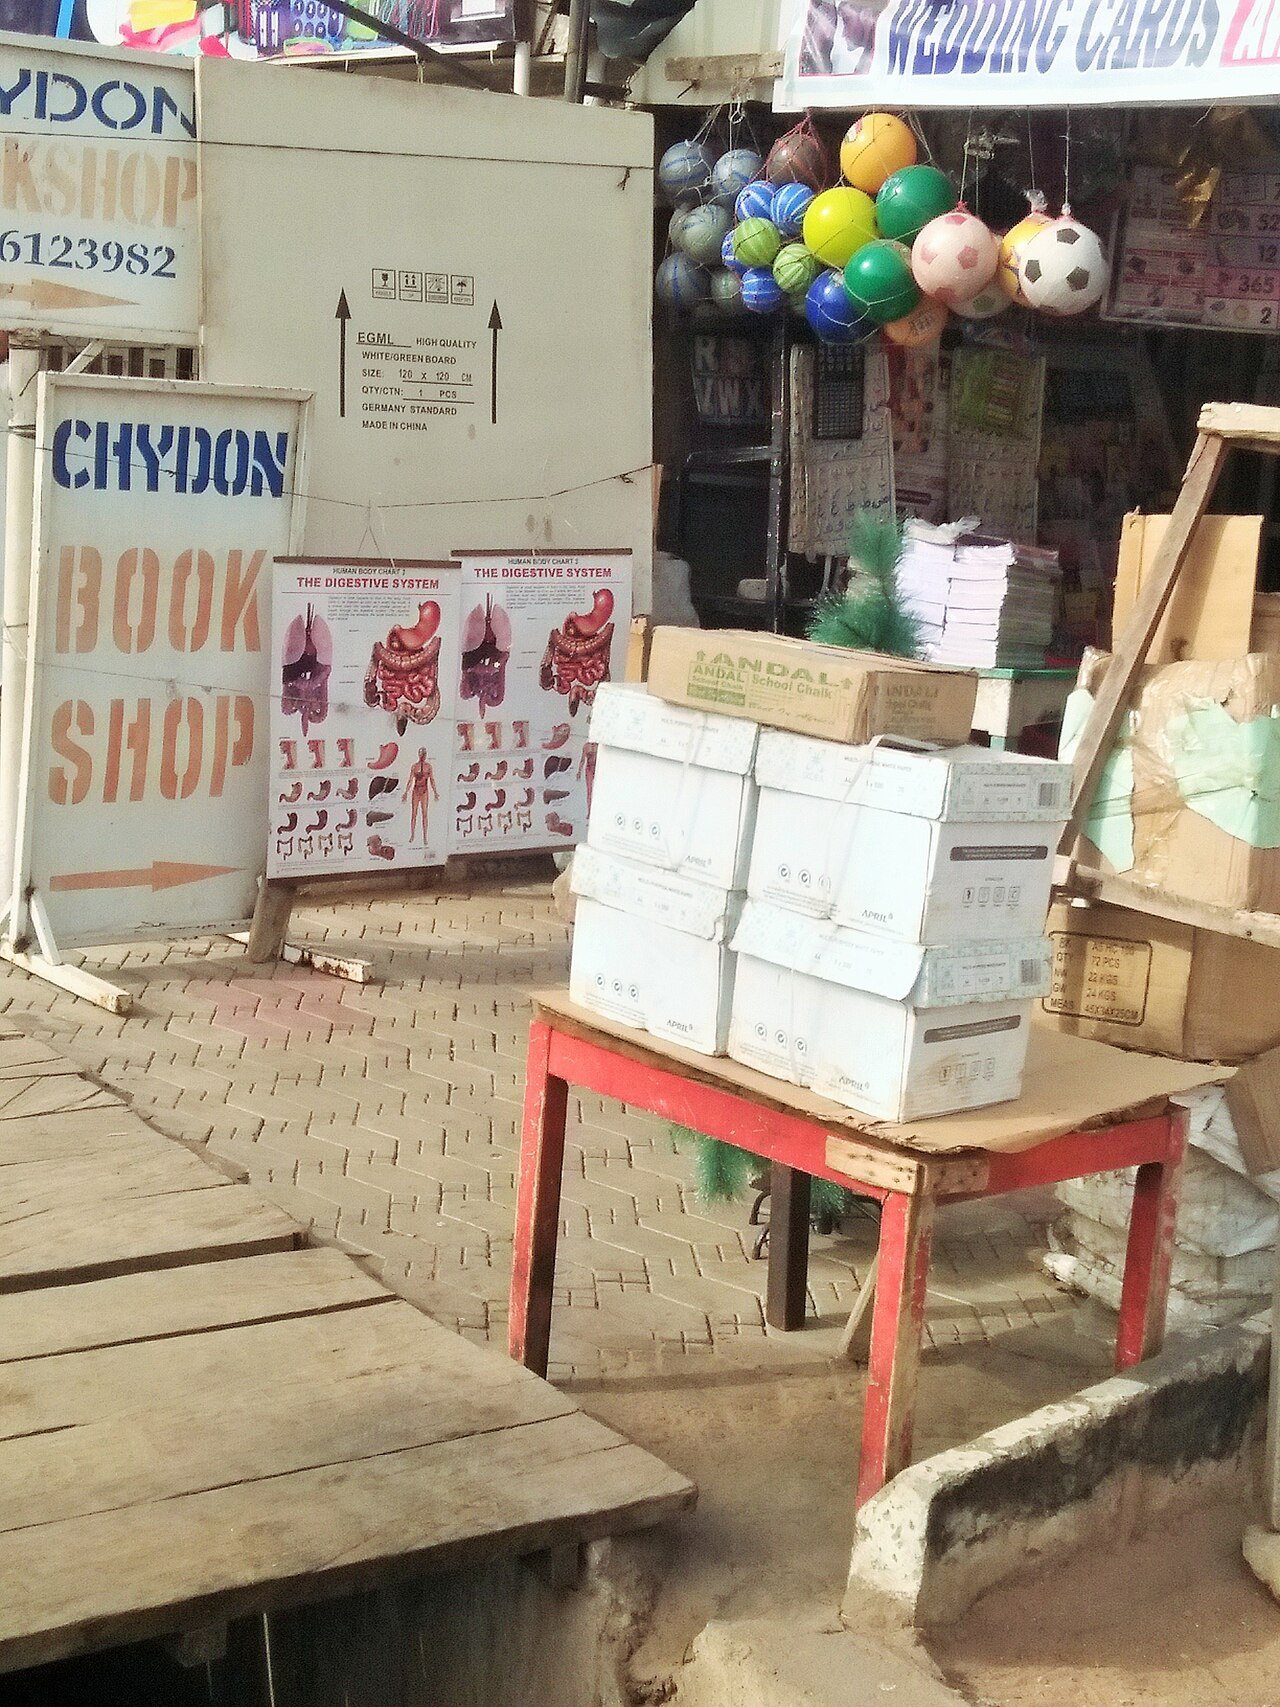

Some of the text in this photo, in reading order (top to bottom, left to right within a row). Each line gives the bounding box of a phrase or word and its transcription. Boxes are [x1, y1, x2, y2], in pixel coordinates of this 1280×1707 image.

[887, 0, 1072, 75] WEDDING
[1075, 0, 1220, 72] CARDS
[0, 229, 177, 279] 6123982
[1238, 274, 1275, 293] 365
[1260, 307, 1272, 324] 2
[358, 331, 477, 349] EGML HIGH QUALITY
[362, 351, 457, 365] WHITE/GREEN BOARD
[399, 369, 413, 379] 120
[436, 372, 449, 381] 120
[461, 373, 472, 382] CM
[362, 386, 404, 396] QTY/CTN:
[439, 390, 457, 399] PCS
[362, 403, 457, 415] GERMANY STANDARD
[362, 420, 428, 431] MADE IN CHINA
[52, 418, 288, 497] CHYDON
[333, 567, 357, 575] HUMAN
[378, 568, 400, 576] CHART
[474, 567, 612, 578] THE DIGESTIVE SYSTEM
[297, 577, 440, 590] THE DIGESTIVE SYSTEM
[55, 545, 268, 654] BOOK
[692, 664, 744, 684] ANDAL
[712, 653, 840, 688] ANDAL
[752, 674, 794, 693] School
[797, 683, 832, 700] Chalk
[48, 695, 255, 805] SHOP
[862, 909, 888, 923] APRIL
[1050, 998, 1074, 1010] MEAS
[667, 1019, 689, 1033] APRIL
[839, 1075, 865, 1091] APRIL
